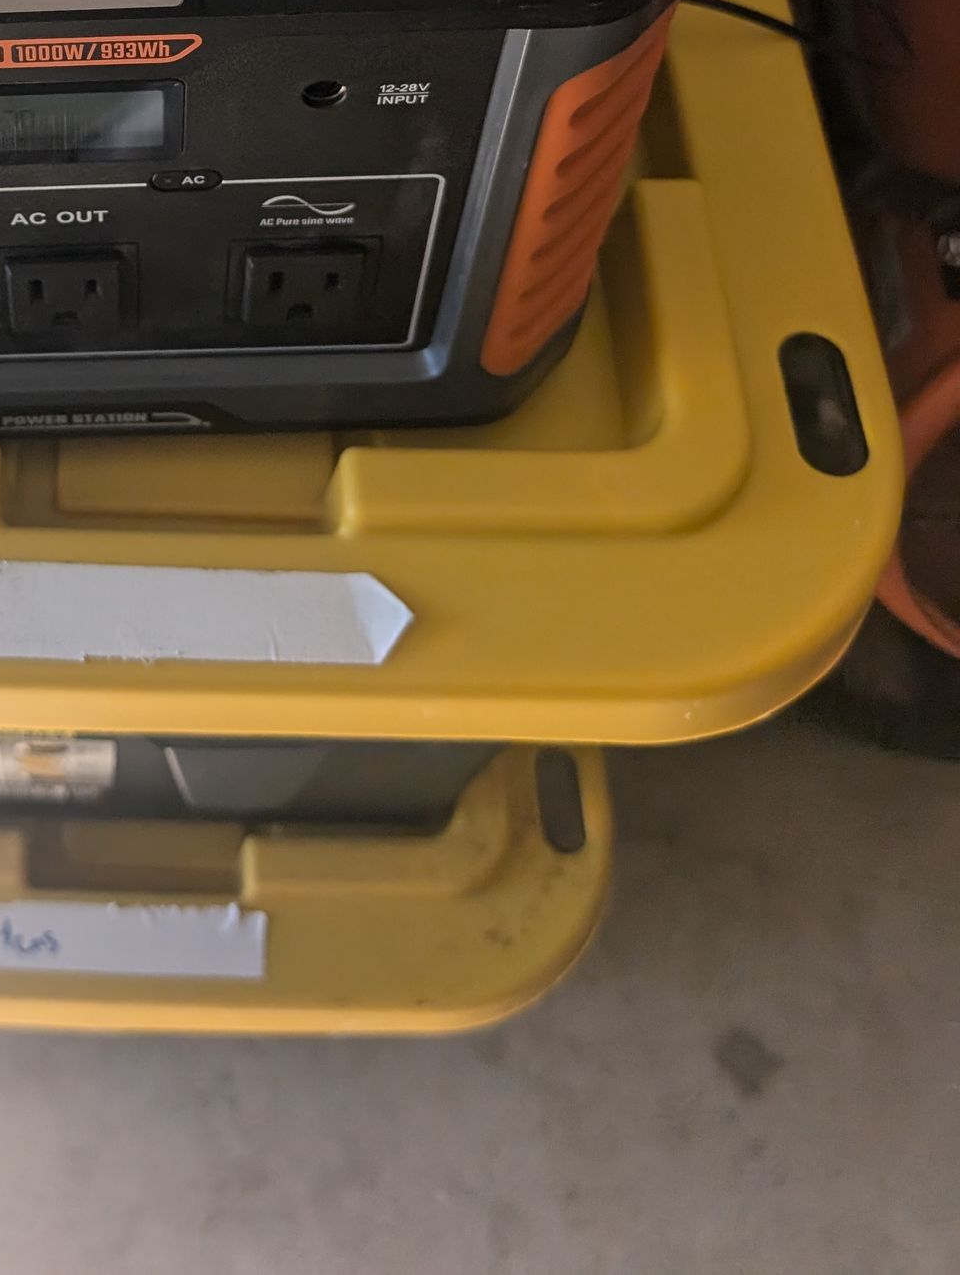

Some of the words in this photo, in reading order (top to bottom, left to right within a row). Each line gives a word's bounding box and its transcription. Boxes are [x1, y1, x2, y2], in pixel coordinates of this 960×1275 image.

[378, 82, 431, 94] 12-28V
[376, 94, 429, 106] INPUT
[181, 173, 206, 186] AC
[10, 210, 47, 226] AC
[56, 208, 109, 224] OUT
[259, 217, 274, 227] AC
[276, 217, 300, 227] Pure
[302, 216, 323, 226] sine
[325, 216, 355, 225] wave
[2, 414, 69, 426] POWER
[72, 412, 148, 424] STATION
